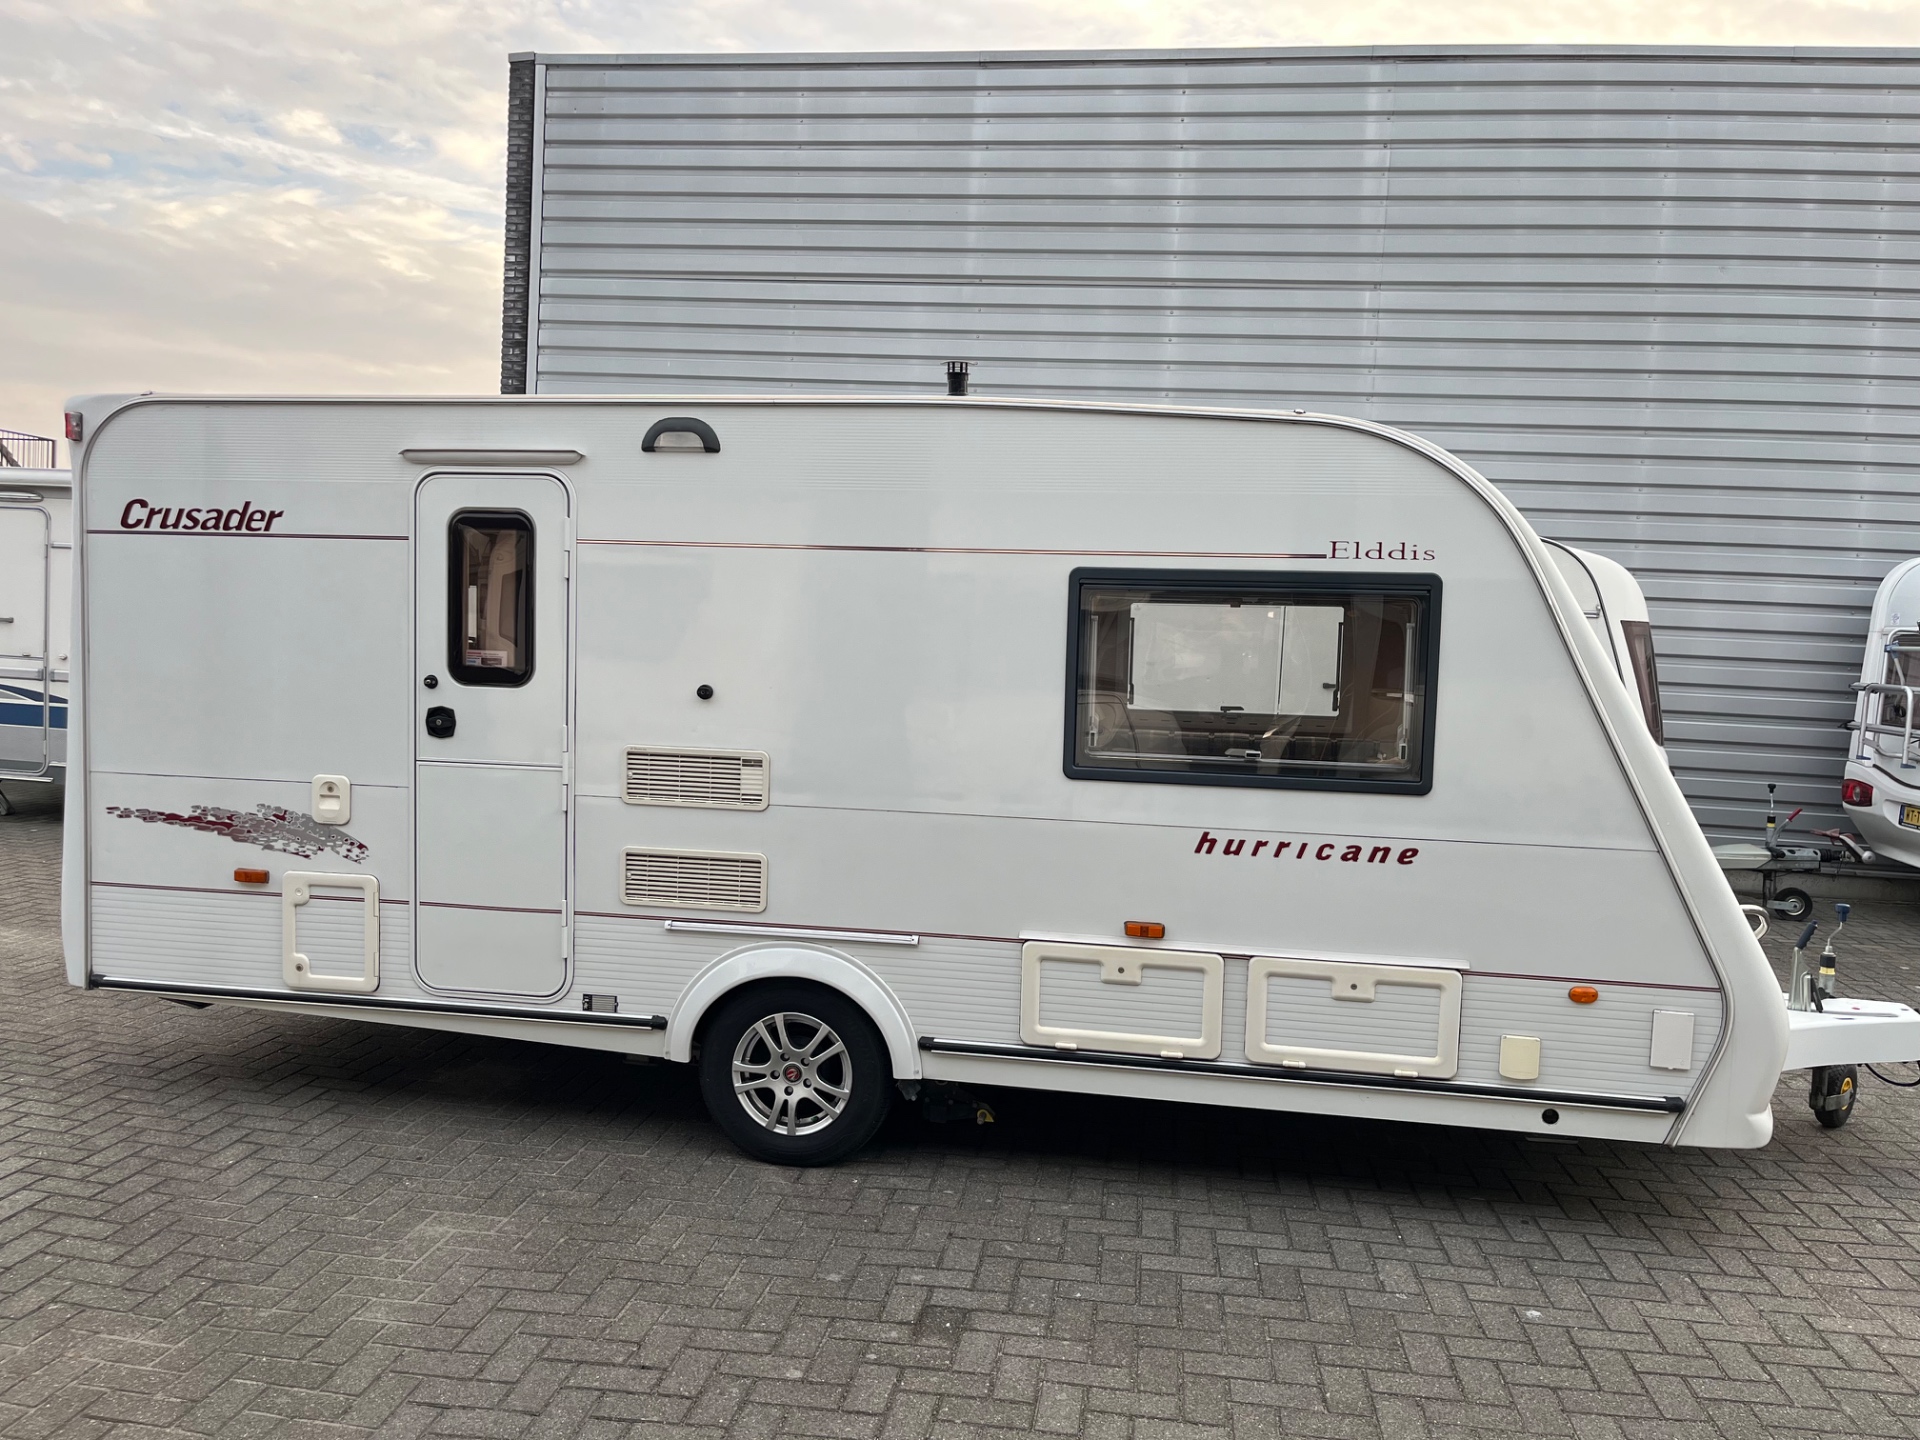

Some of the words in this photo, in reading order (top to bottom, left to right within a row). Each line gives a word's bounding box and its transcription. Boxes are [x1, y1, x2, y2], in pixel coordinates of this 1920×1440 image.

[120, 498, 284, 532] Crusader
[1328, 541, 1436, 561] Elddis
[1194, 831, 1419, 865] hurricane
